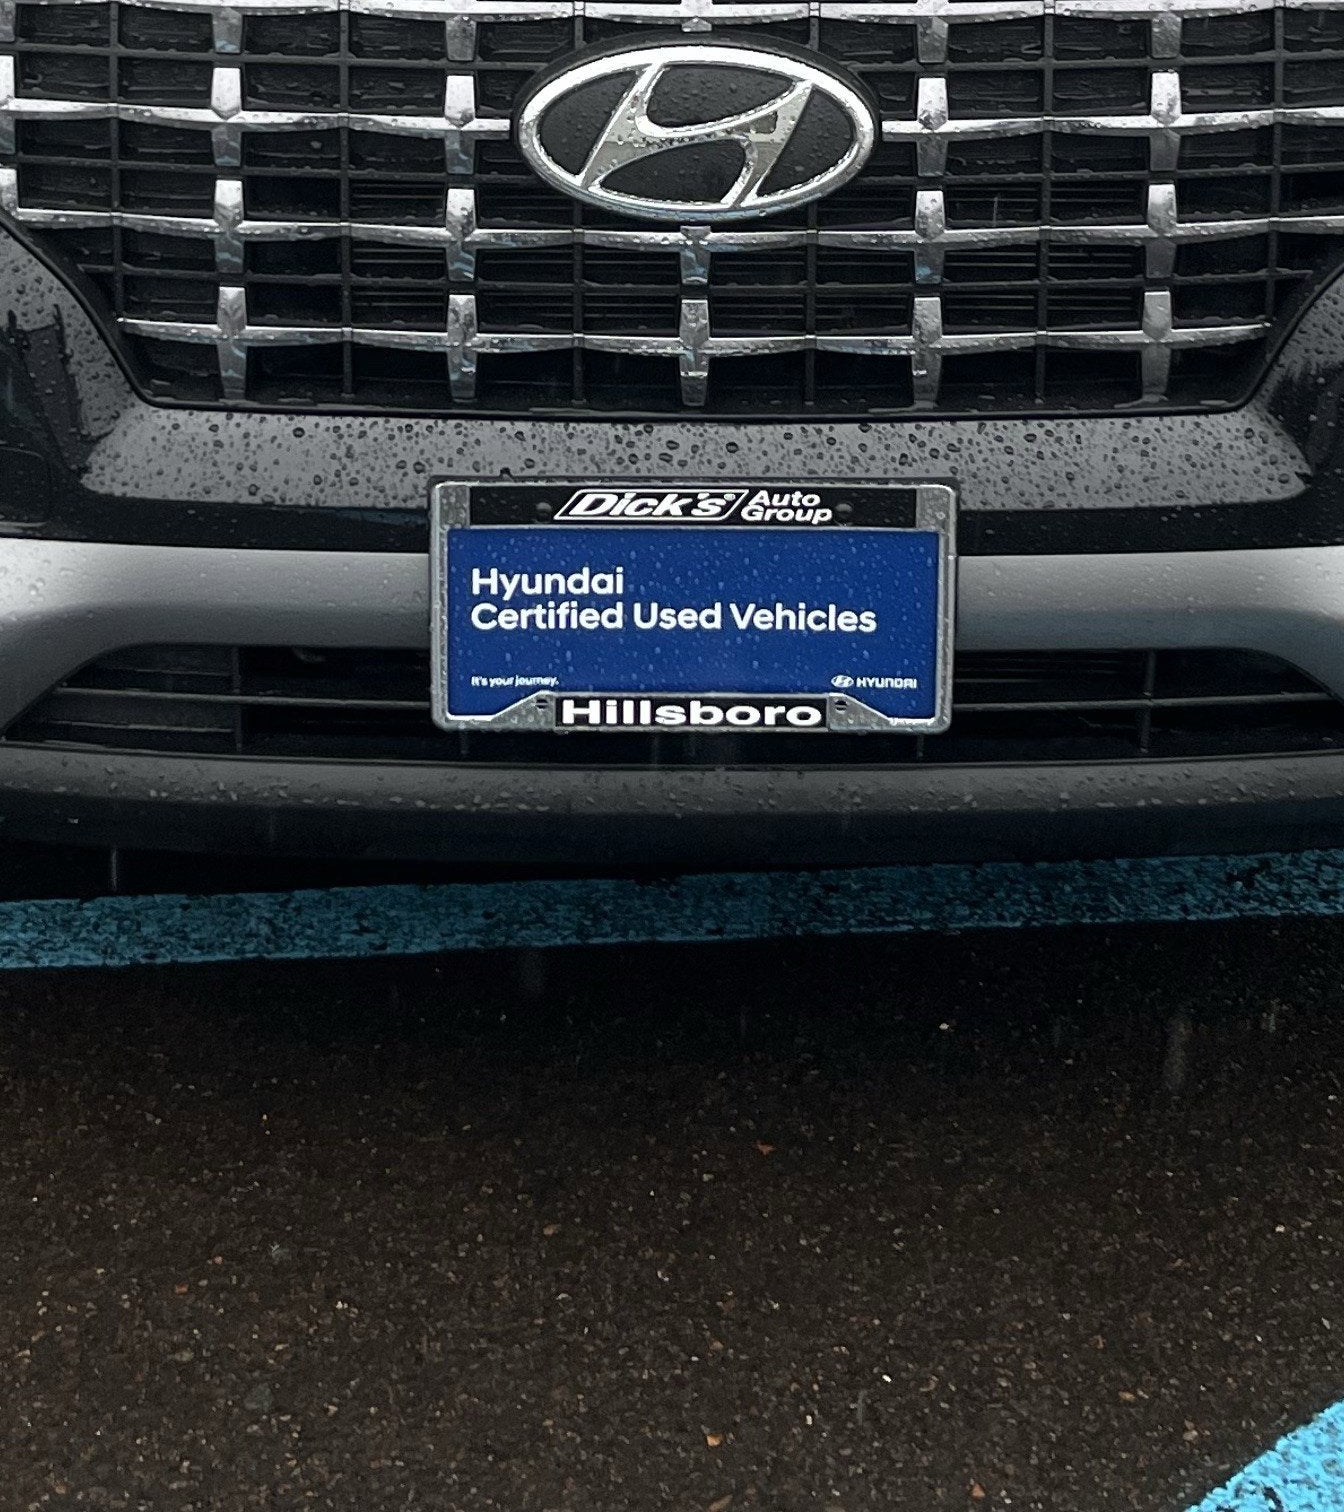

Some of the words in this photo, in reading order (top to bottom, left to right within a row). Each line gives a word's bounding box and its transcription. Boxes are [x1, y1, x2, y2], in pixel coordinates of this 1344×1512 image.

[749, 490, 821, 507] Auto
[740, 505, 833, 525] Group
[471, 566, 624, 601] Hyundai
[470, 600, 624, 630] Certified
[632, 601, 722, 630] Used
[729, 601, 878, 633] Vehicles
[489, 676, 514, 687] your
[856, 677, 918, 689] HYUNDAI
[562, 699, 823, 727] Hillsboro
